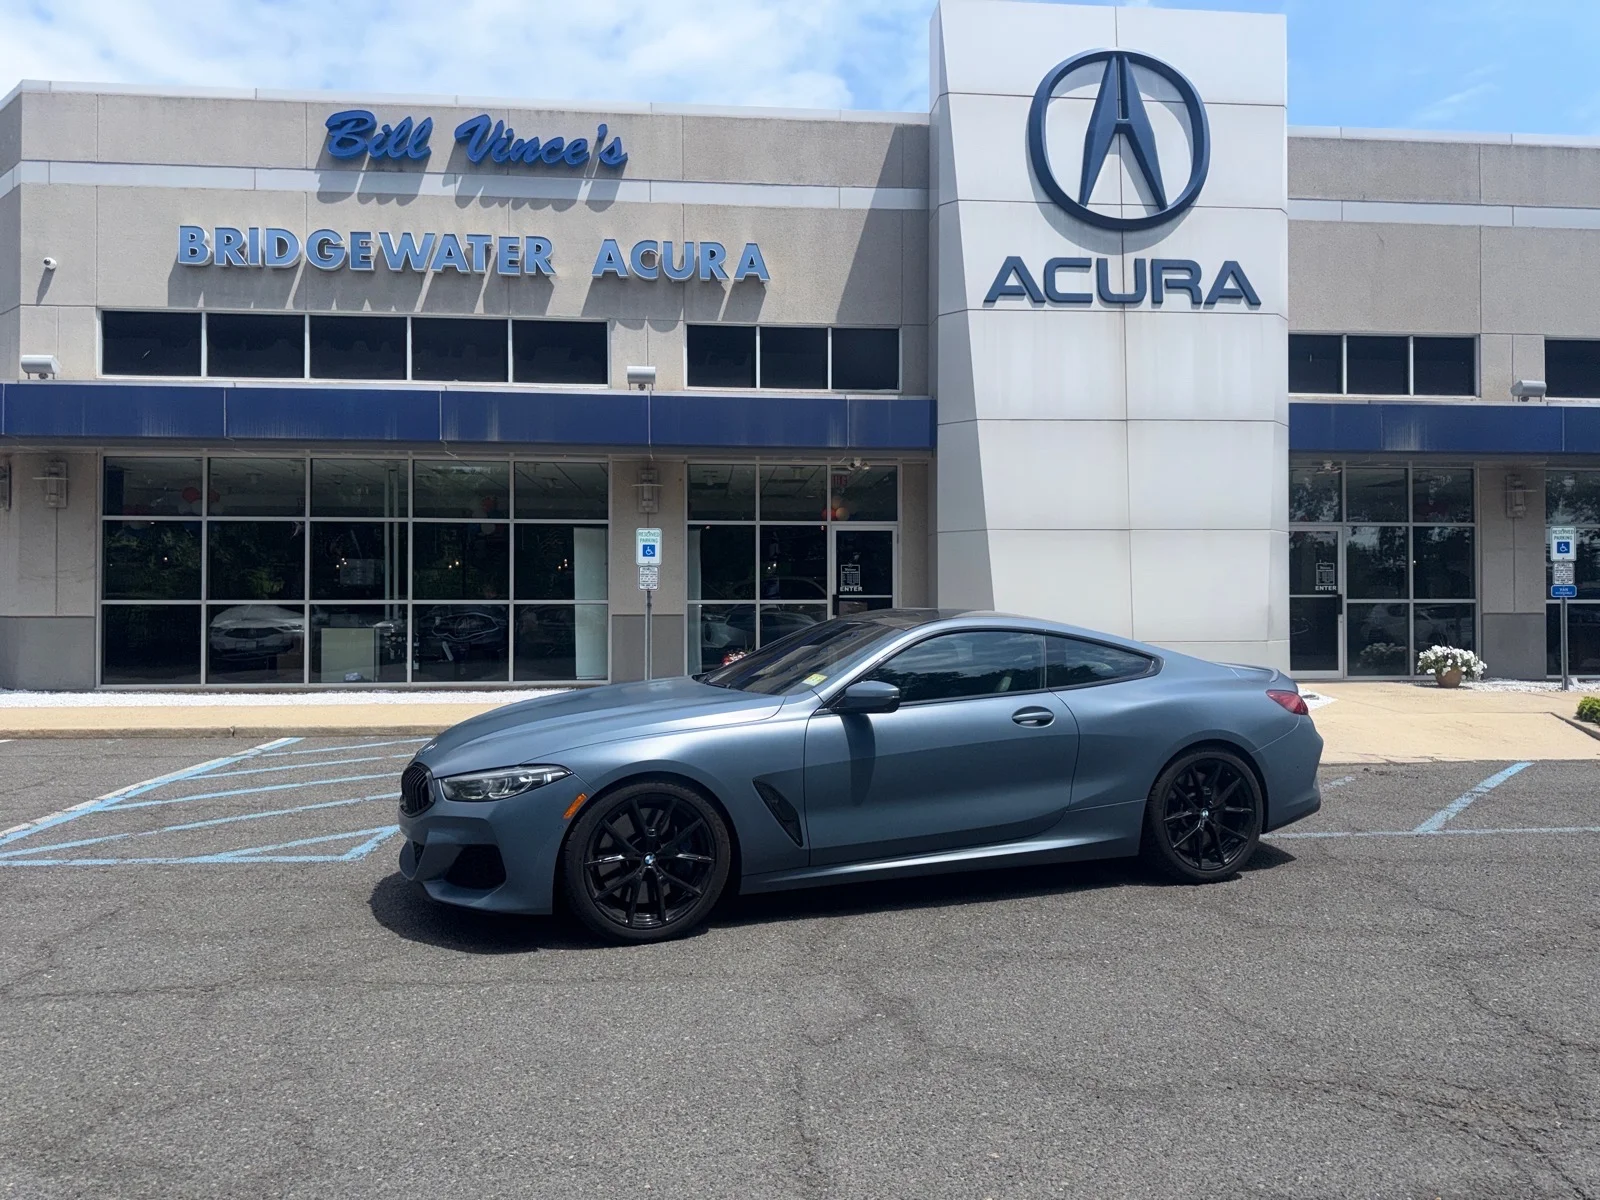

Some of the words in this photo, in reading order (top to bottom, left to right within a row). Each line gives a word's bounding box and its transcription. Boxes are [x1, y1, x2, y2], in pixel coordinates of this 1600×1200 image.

[325, 109, 432, 161] Bill
[455, 114, 629, 169] Vince's
[177, 225, 556, 277] BRIDGEWATER
[592, 239, 771, 283] ACURA
[983, 255, 1262, 306] ACURA
